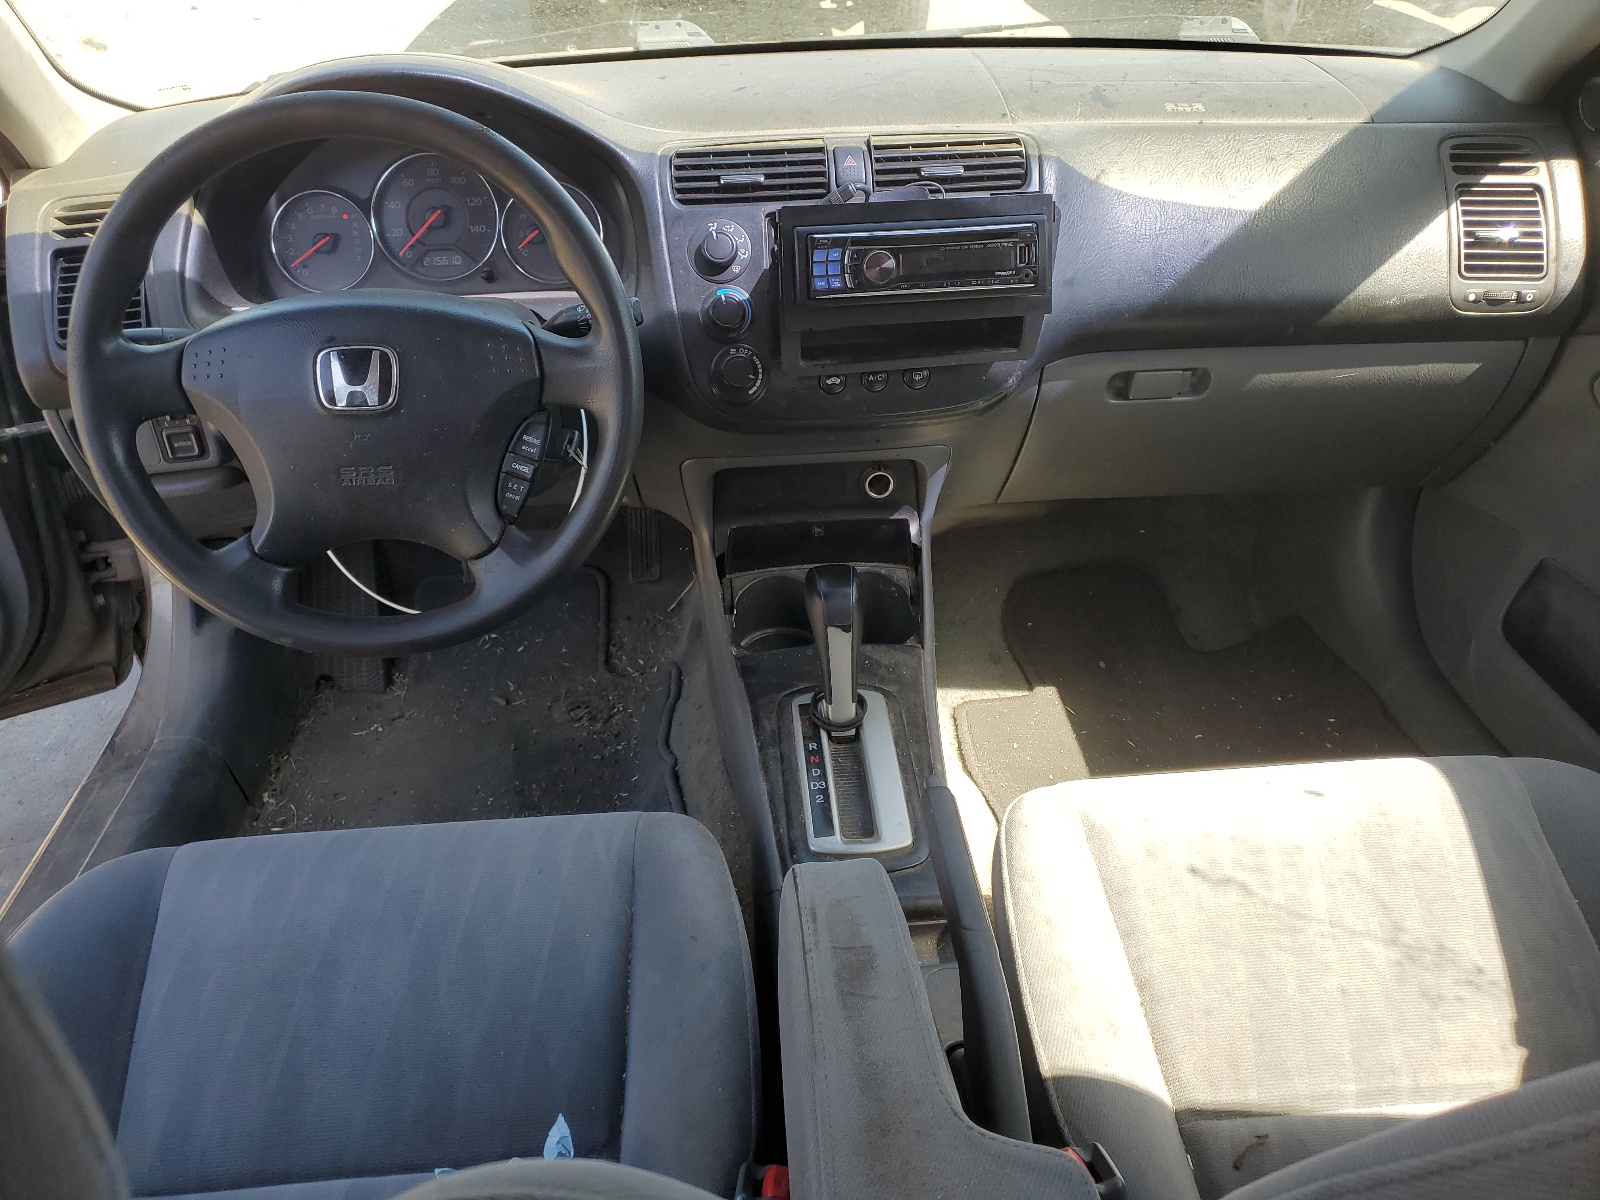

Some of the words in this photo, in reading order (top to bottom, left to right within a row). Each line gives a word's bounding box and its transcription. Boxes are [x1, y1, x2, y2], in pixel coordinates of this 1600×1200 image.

[427, 167, 439, 176] 80
[402, 178, 415, 187] 60
[450, 176, 466, 185] 100
[388, 200, 401, 209] 40
[466, 197, 483, 206] 120
[306, 206, 314, 215] 6
[331, 206, 338, 214] 8
[391, 228, 404, 237] 20
[469, 224, 486, 234] 140
[522, 249, 529, 257] C
[302, 269, 309, 277] 0
[739, 347, 753, 357] OFF
[868, 373, 883, 382] A/C
[522, 434, 541, 446] RESUME
[521, 445, 537, 454] accel
[511, 462, 530, 474] CANCEL
[808, 742, 818, 751] R
[810, 755, 820, 763] N
[811, 768, 821, 776] D
[810, 780, 827, 790] D3
[815, 794, 825, 803] 2
